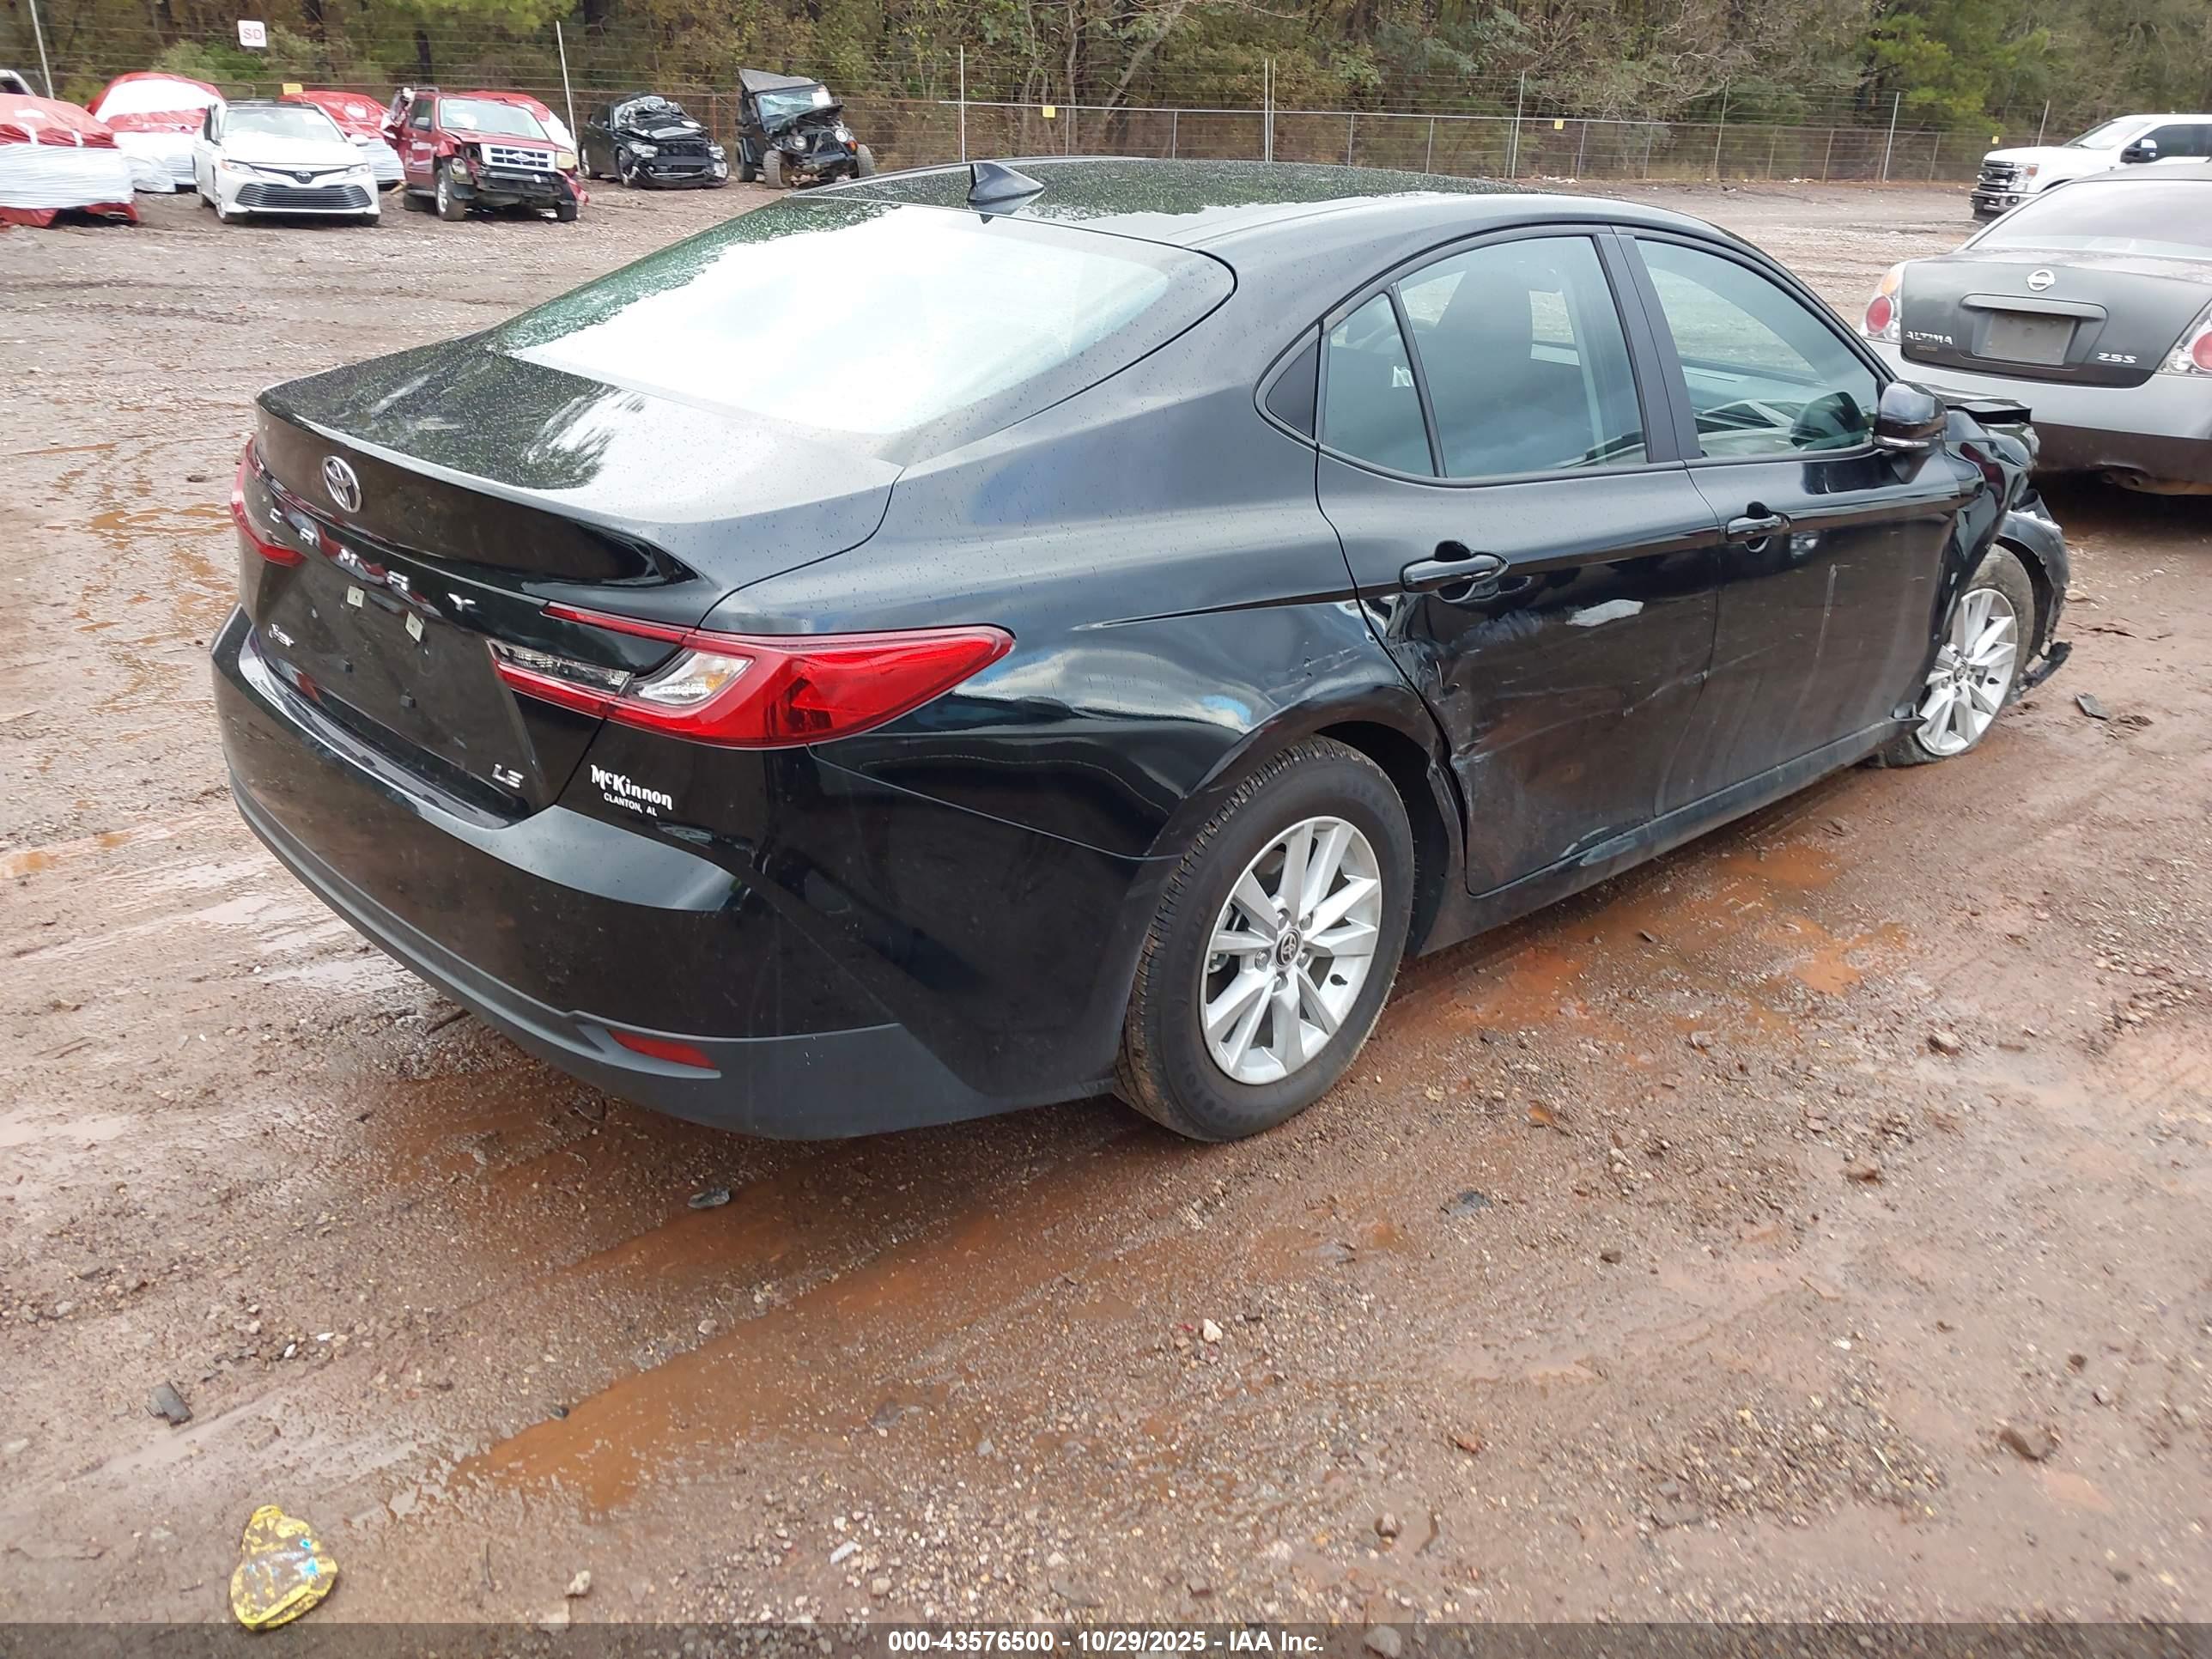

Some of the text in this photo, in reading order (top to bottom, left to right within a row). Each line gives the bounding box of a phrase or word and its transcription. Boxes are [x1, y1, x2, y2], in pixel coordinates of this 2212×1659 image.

[243, 27, 263, 40] SD
[491, 763, 525, 789] LE
[590, 764, 673, 811] McKinnon
[604, 792, 659, 817] CLANTON, AL
